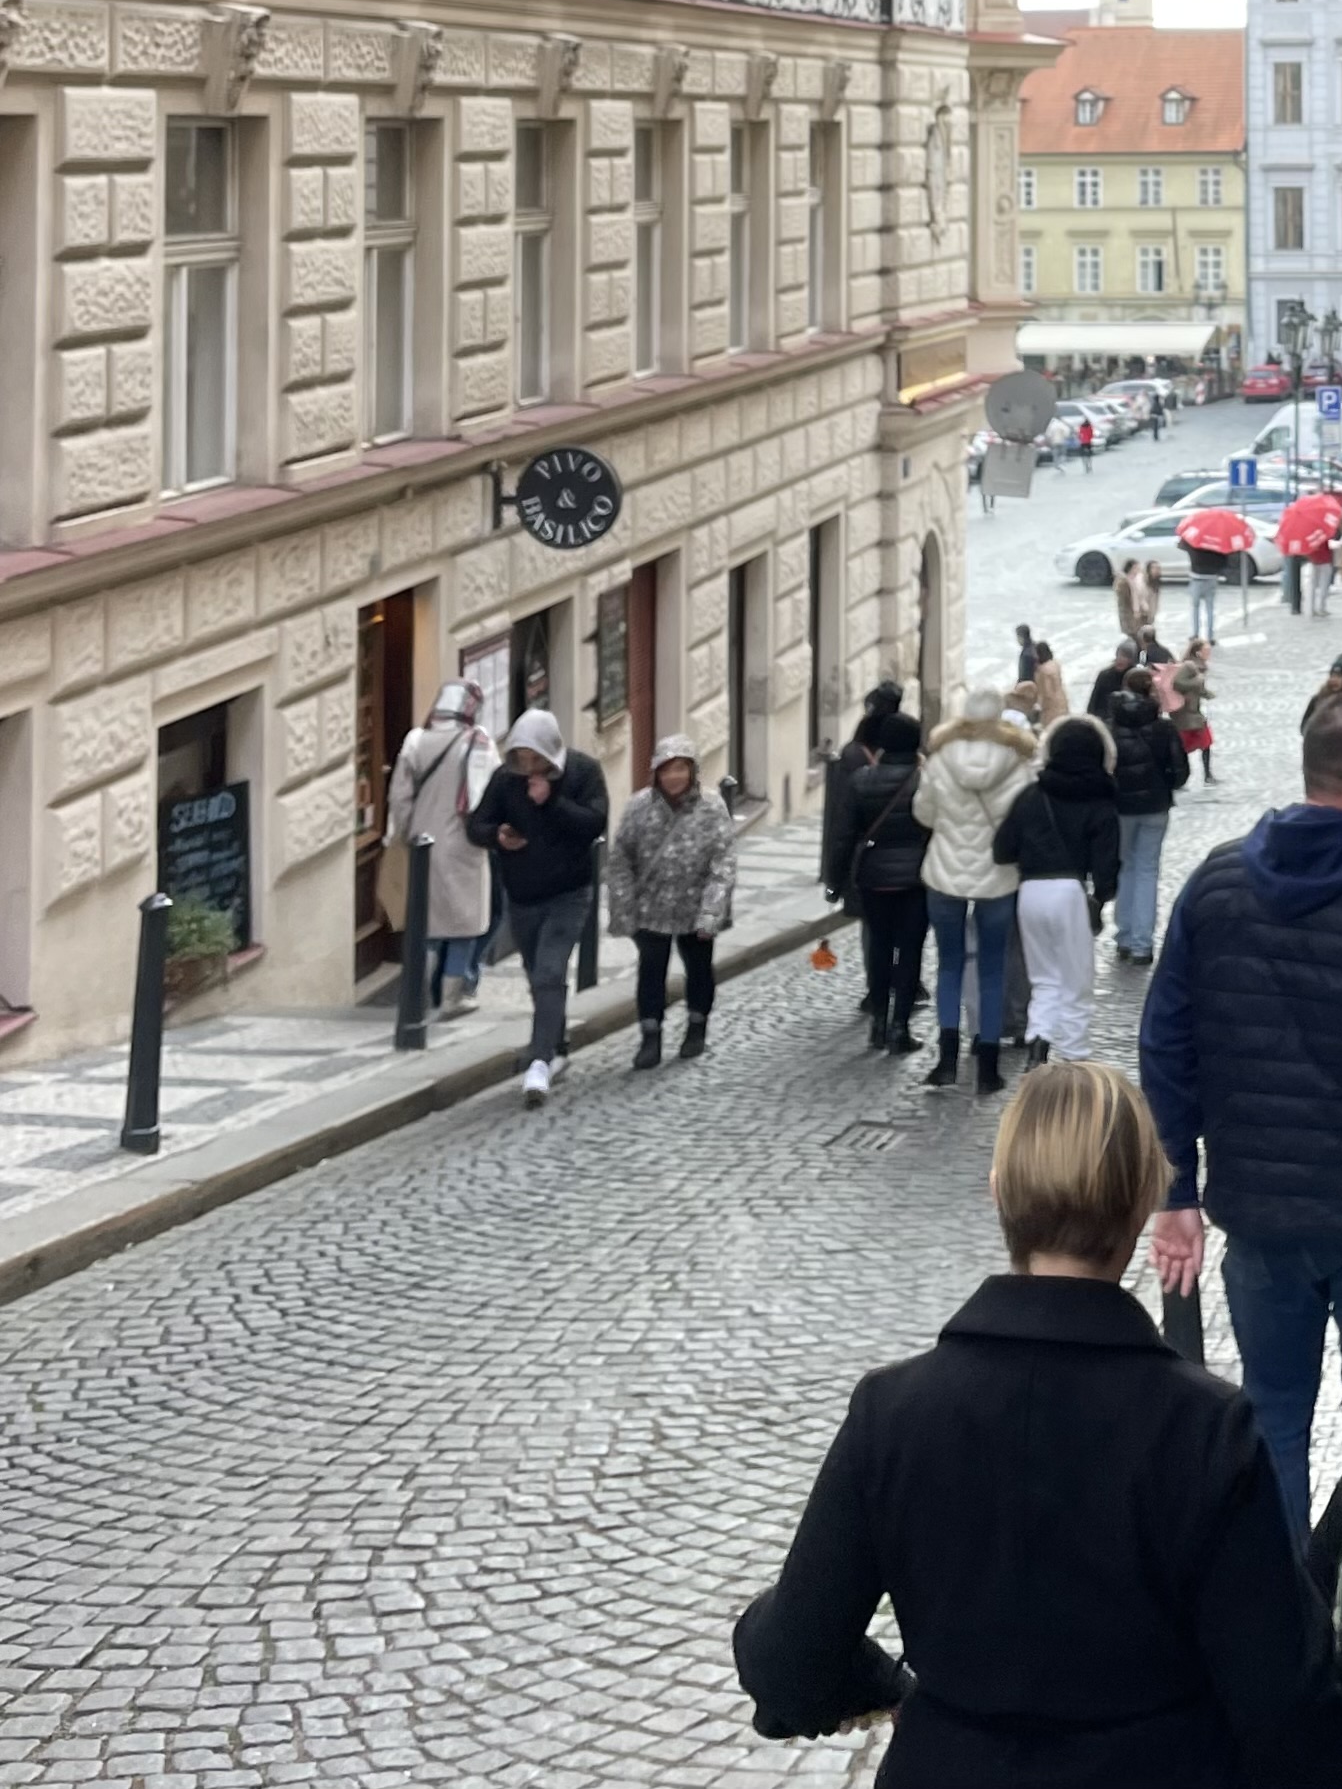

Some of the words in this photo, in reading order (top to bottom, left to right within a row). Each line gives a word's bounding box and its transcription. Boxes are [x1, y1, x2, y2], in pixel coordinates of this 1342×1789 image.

[1321, 391, 1338, 411] P
[534, 451, 602, 483] PIVO
[556, 487, 577, 509] &
[521, 494, 614, 544] BASILICO
